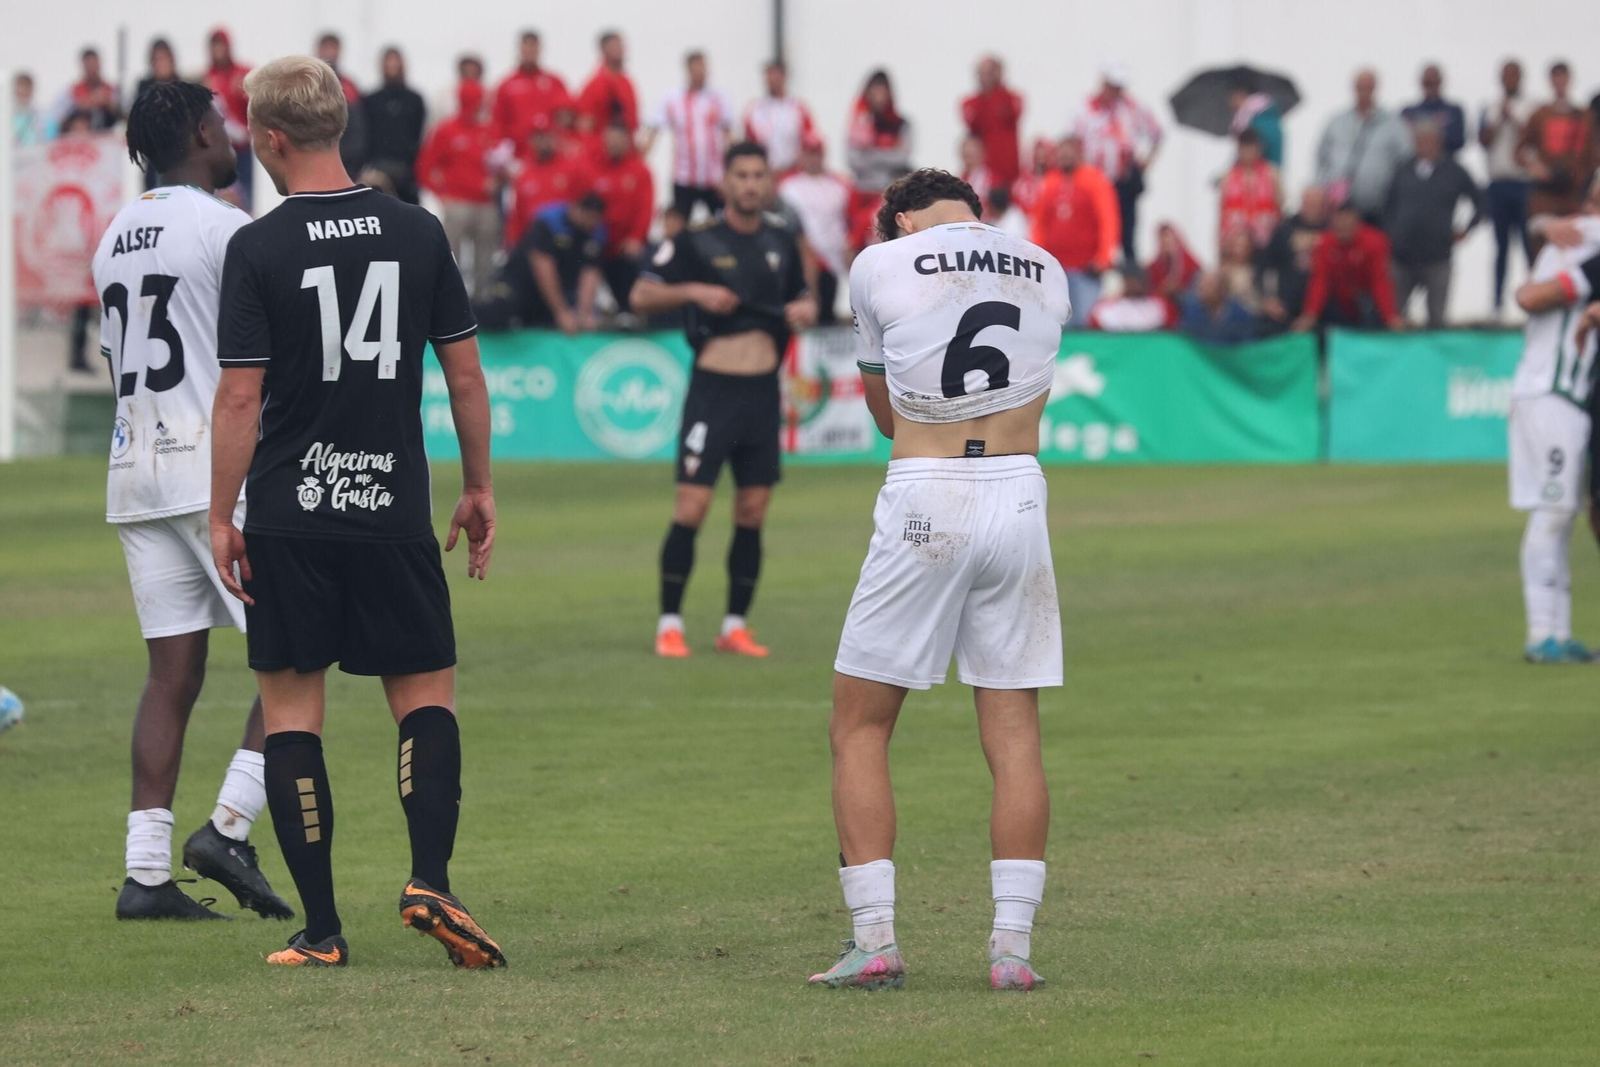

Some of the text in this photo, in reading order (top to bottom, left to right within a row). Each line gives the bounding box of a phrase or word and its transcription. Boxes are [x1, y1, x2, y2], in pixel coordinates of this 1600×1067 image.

[111, 226, 164, 258] ALSET
[305, 215, 382, 242] NADER
[914, 250, 1045, 283] CLIMENT
[102, 273, 185, 398] 23
[300, 260, 401, 382] 14
[941, 301, 1021, 399] 6
[685, 421, 708, 455] 4
[299, 441, 397, 485] Algeciras
[1549, 447, 1565, 476] 9
[331, 476, 395, 512] Gusta
[355, 473, 373, 486] me
[903, 527, 931, 547] laga
[909, 516, 932, 532] má
